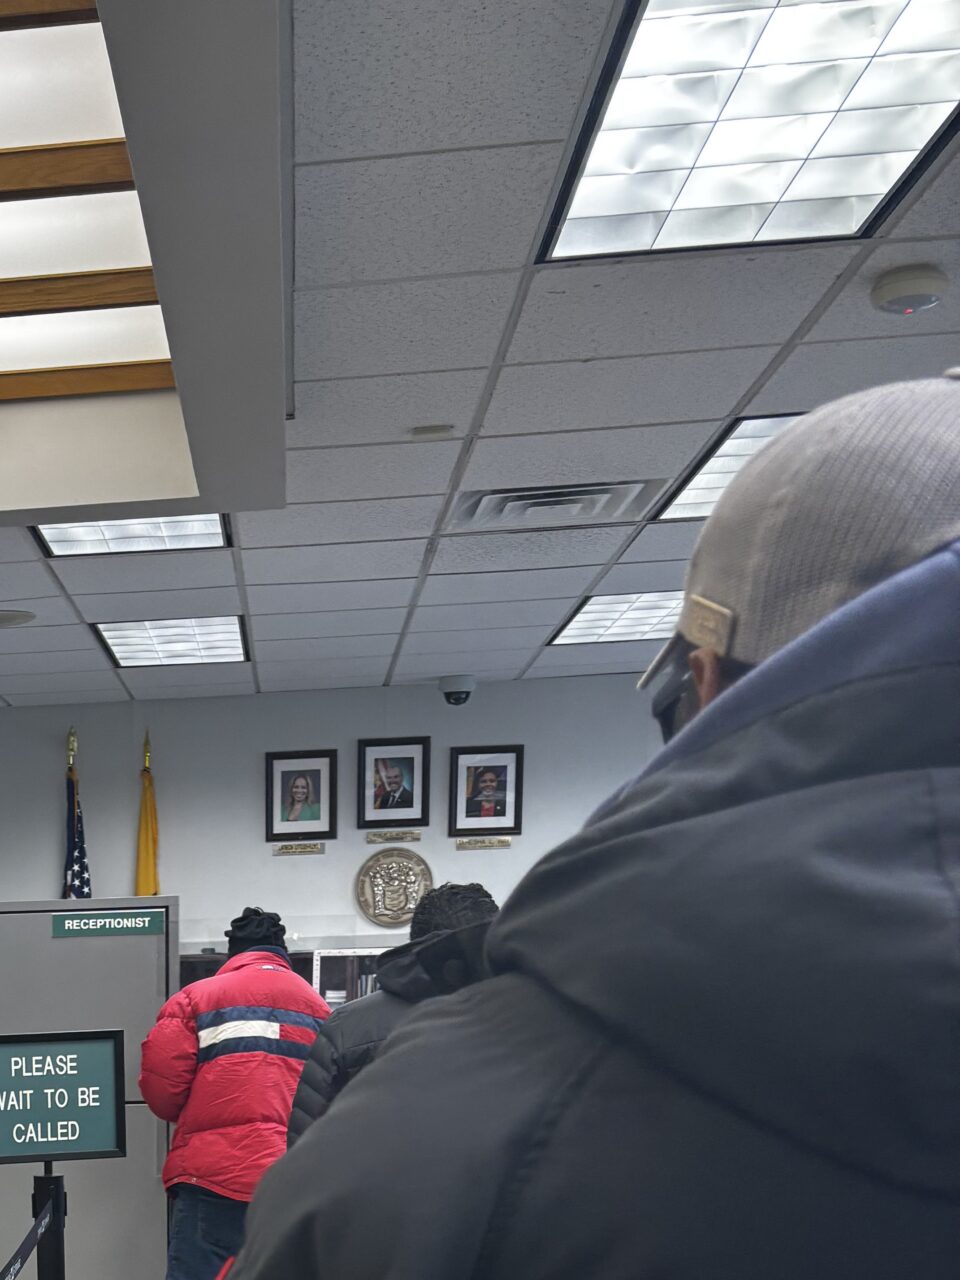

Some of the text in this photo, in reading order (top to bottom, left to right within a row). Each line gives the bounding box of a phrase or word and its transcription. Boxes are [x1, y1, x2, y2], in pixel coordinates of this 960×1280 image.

[65, 918, 151, 930] RECEPTIONIST
[11, 1055, 77, 1076] PLEASE
[44, 1089, 68, 1108] TO
[78, 1087, 100, 1107] BE
[13, 1121, 80, 1143] CALLED
